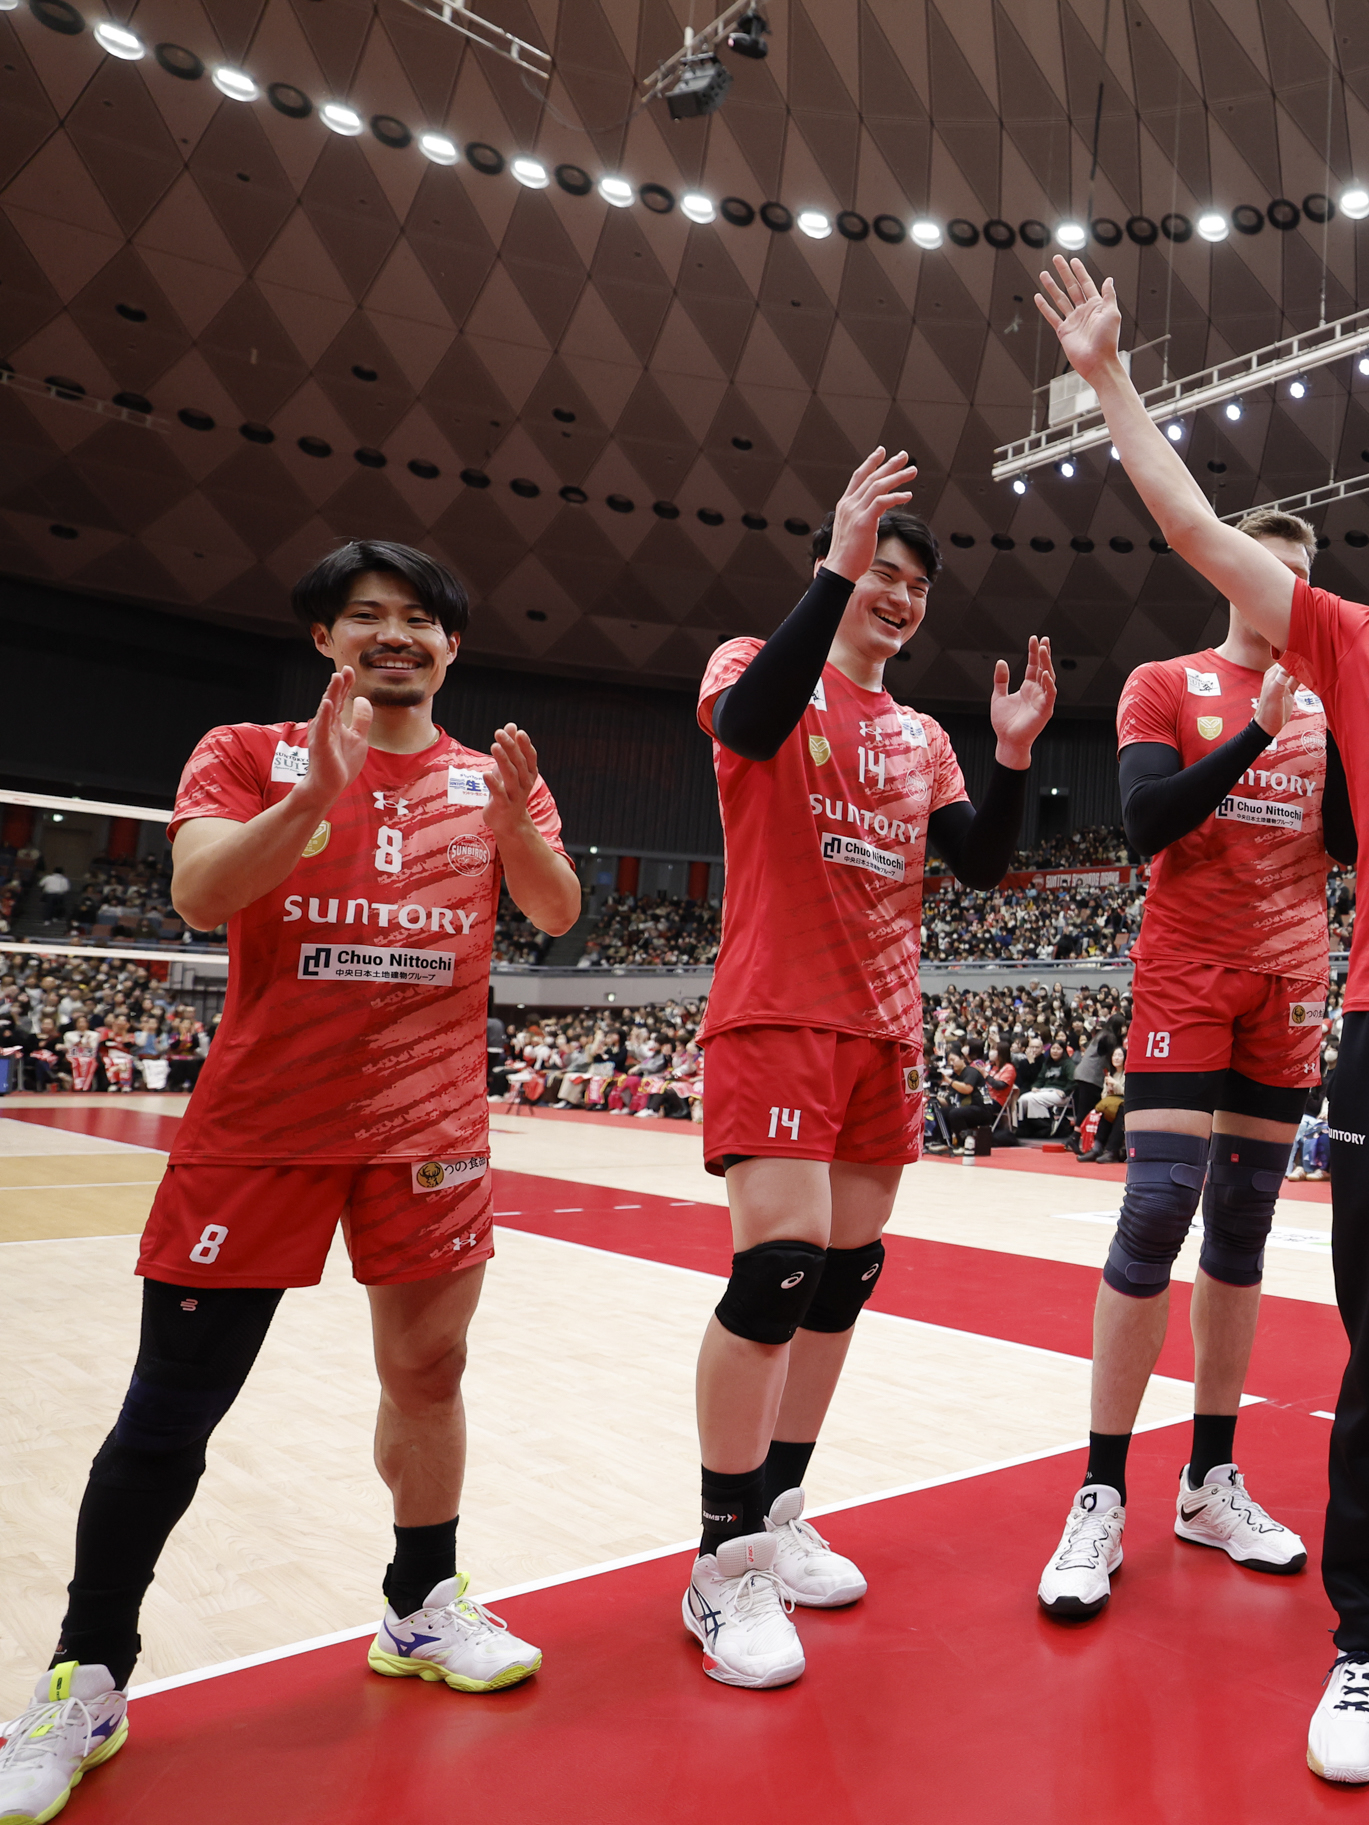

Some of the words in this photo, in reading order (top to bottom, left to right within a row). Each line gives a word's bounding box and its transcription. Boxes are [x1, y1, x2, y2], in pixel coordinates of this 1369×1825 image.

[857, 746, 886, 790] 14
[1238, 768, 1317, 797] NTORY
[809, 793, 921, 844] SUNTORY
[1237, 801, 1263, 814] Chuo
[1266, 805, 1302, 821] Nittochi
[374, 825, 402, 874] 8
[451, 845, 488, 863] SUNBIRDS
[845, 842, 871, 858] Chuo
[872, 850, 904, 871] Nittochi
[283, 894, 478, 935] SUNTORY
[335, 968, 436, 982] 中央日本土地建物グループ
[337, 950, 384, 966] Chuo
[389, 953, 452, 971] Nittochi
[1145, 1032, 1171, 1058] 13
[768, 1106, 801, 1140] 14
[1328, 1128, 1366, 1145] UNTORY
[189, 1223, 229, 1264] 8
